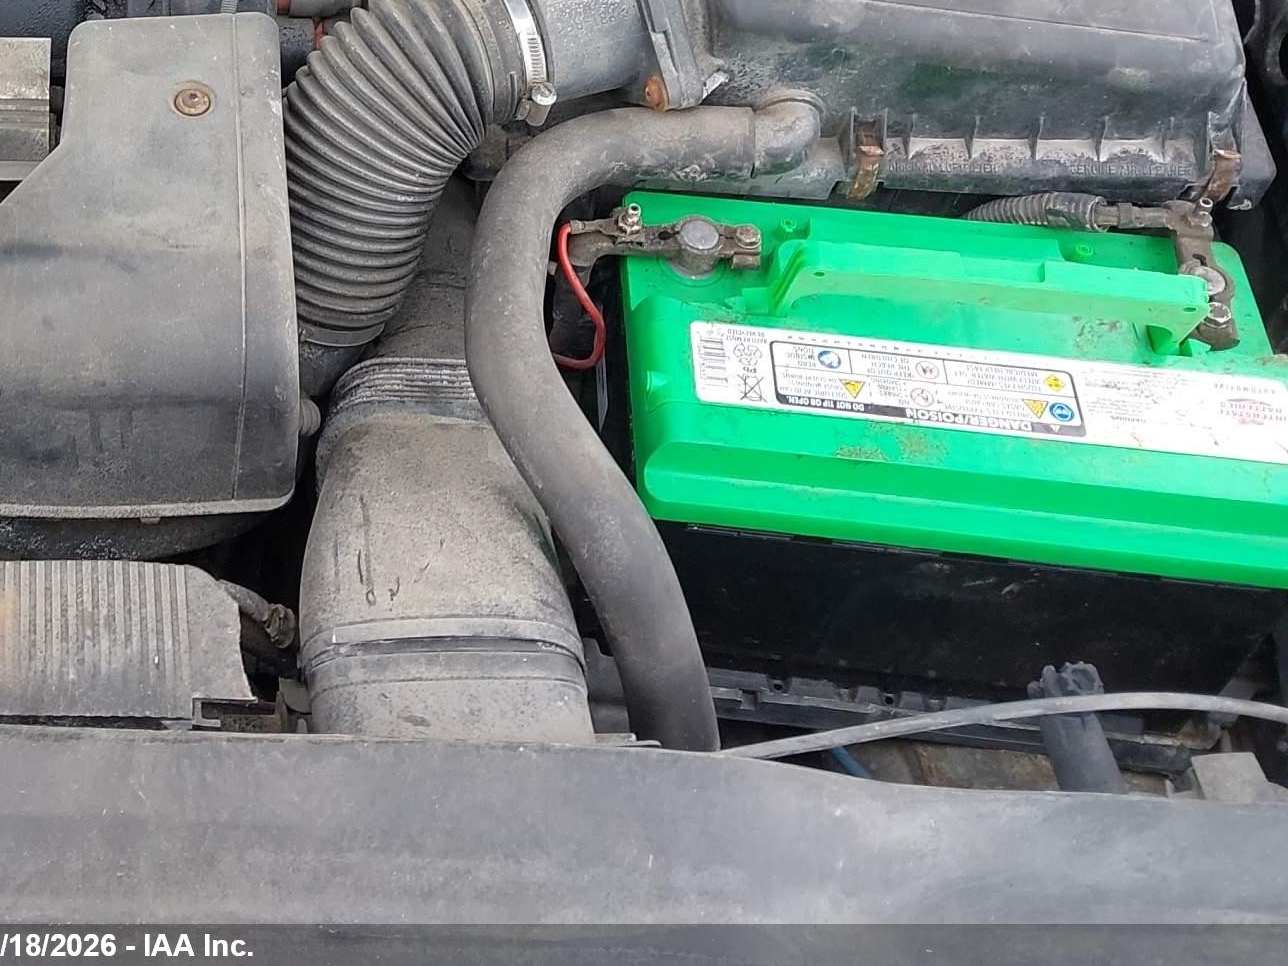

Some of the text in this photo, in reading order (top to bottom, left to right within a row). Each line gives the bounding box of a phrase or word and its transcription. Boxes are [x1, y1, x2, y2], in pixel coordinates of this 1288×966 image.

[742, 366, 757, 374] Pb
[1213, 383, 1276, 395] AUTOMOTIVE
[810, 398, 822, 407] OR
[823, 400, 836, 409] TIP
[836, 401, 852, 410] NOT
[853, 403, 865, 412] DO
[1220, 401, 1283, 415] BATTERIES
[905, 408, 1033, 433] DANGER/POISON
[1220, 410, 1287, 423] INTERSTATE
